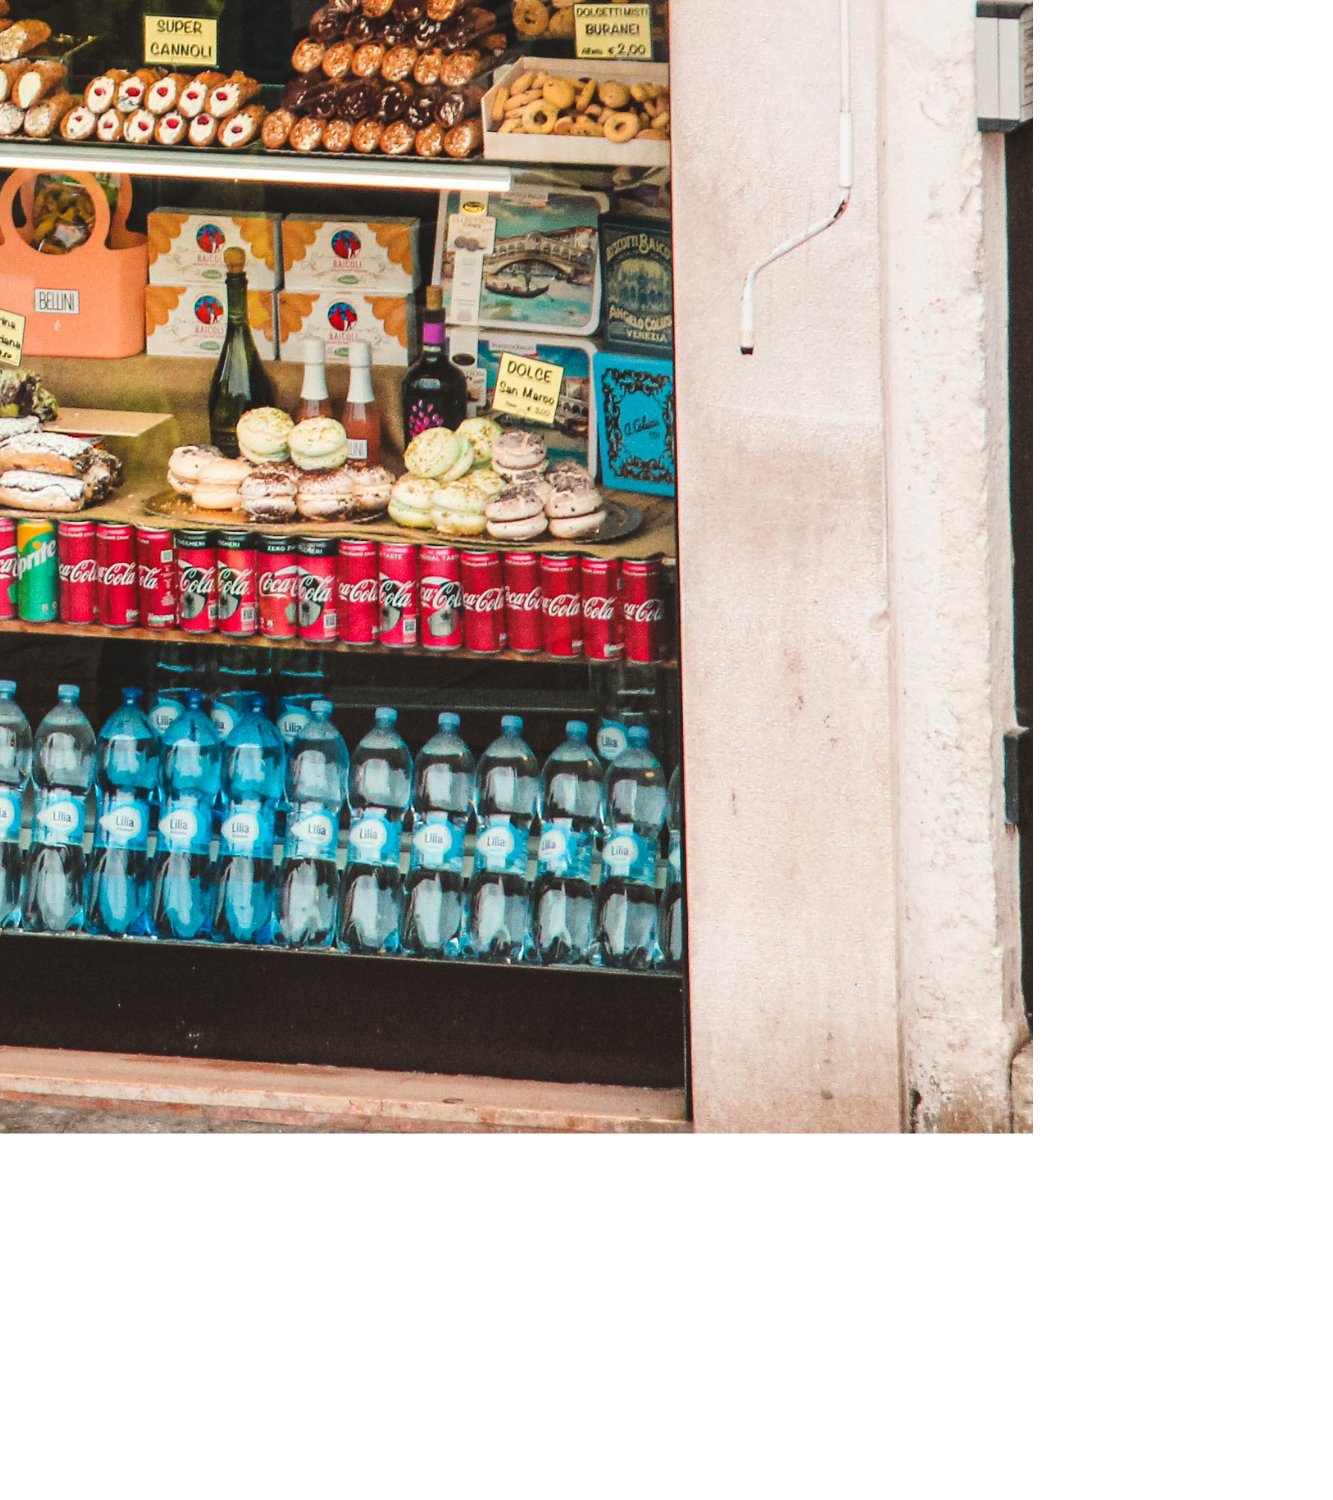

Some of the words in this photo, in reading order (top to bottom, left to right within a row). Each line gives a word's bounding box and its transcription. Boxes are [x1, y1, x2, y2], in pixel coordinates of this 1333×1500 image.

[576, 7, 622, 18] DOLCETTI
[623, 7, 649, 17] MISTI
[157, 19, 203, 34] SUPER
[585, 22, 640, 36] BURANEI
[150, 41, 212, 58] CANNOLI
[639, 232, 671, 261] BAICO
[197, 254, 223, 263] BAICOL
[39, 291, 75, 311] BELLINI
[625, 329, 668, 342] VENEZIA
[506, 360, 553, 383] DOLCE
[498, 380, 519, 396] San
[522, 385, 555, 405] Marco
[52, 810, 72, 823] Lilia
[115, 815, 134, 828] Lilia
[169, 818, 188, 831] Lilia
[231, 821, 250, 834] Lilia
[308, 823, 327, 836] Lilia
[359, 827, 378, 840] Lilia
[424, 832, 444, 845] Lilia
[487, 834, 506, 847] Lilia
[541, 839, 556, 851] Lilia
[611, 844, 630, 857] Lilia
